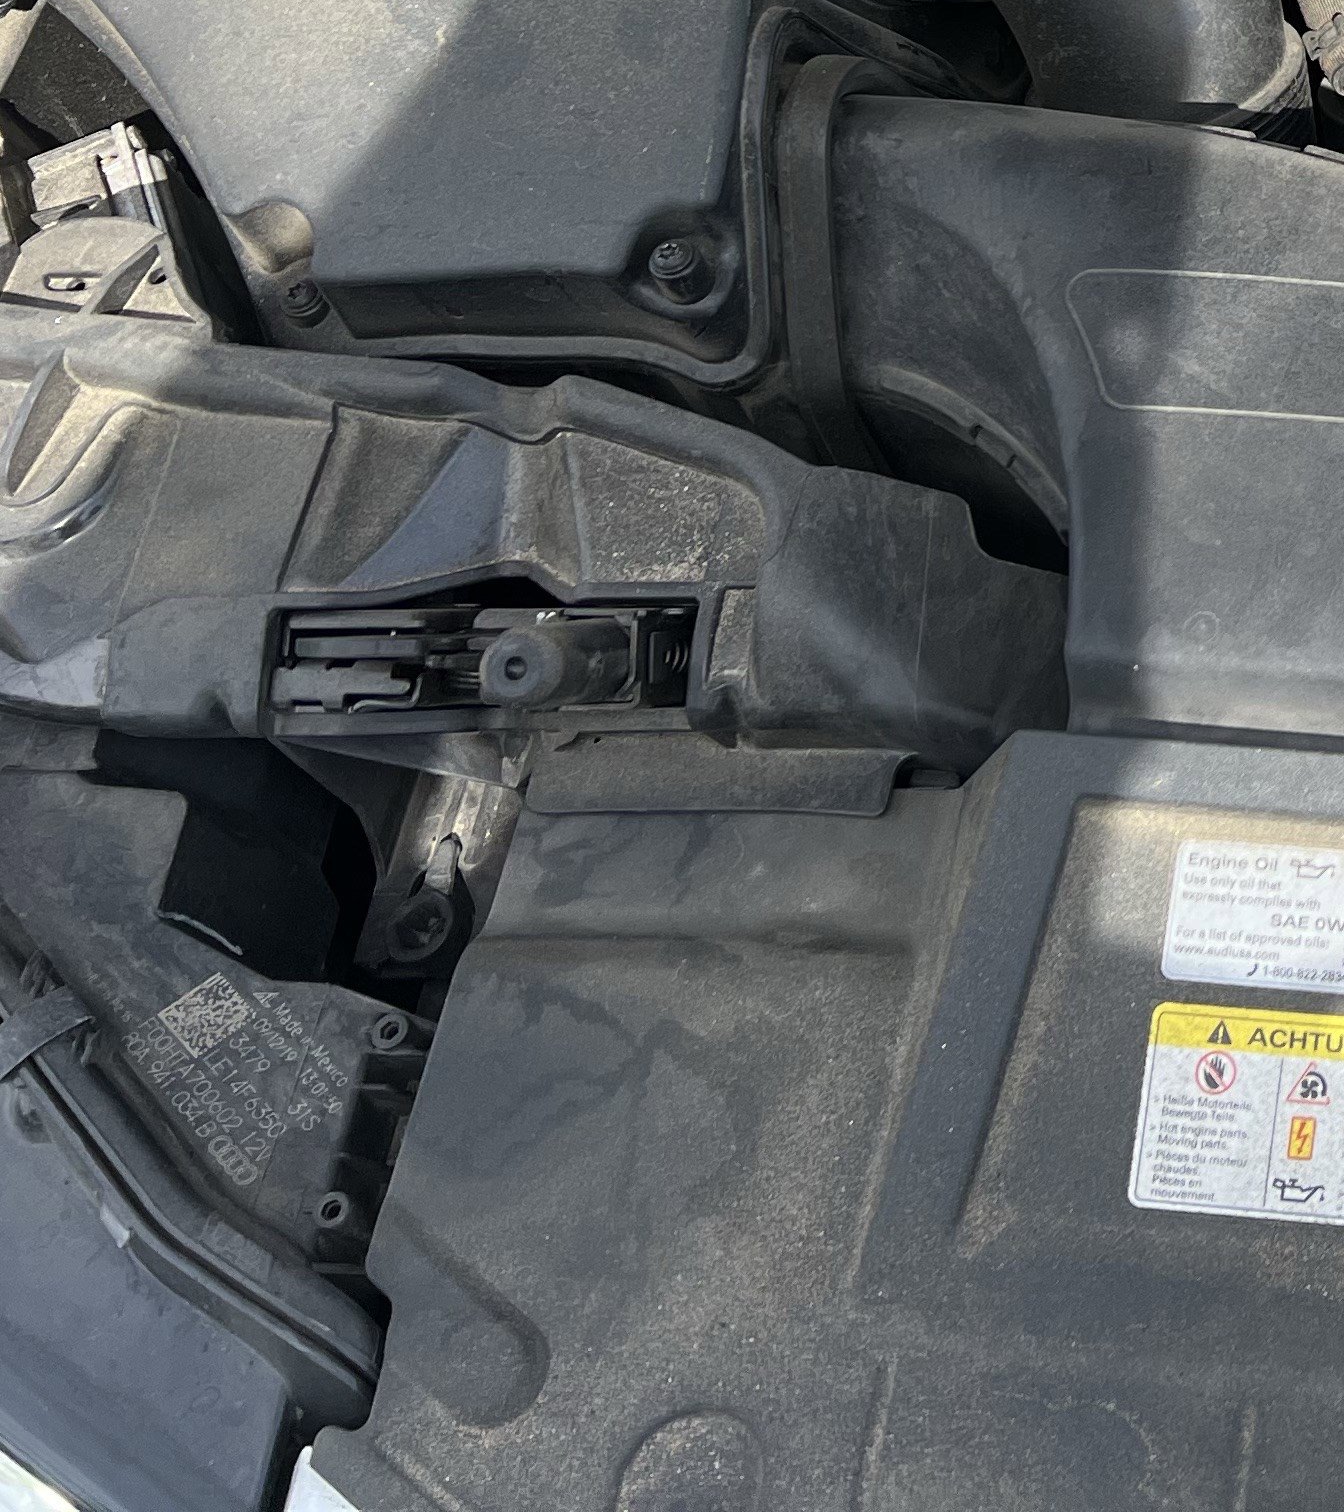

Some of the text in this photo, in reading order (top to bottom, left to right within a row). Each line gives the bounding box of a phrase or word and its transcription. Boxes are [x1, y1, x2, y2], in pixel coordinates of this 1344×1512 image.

[1187, 852, 1278, 874] Engine Oil
[1183, 873, 1207, 886] Use
[1210, 875, 1235, 890] only
[1257, 878, 1281, 892] that
[1239, 893, 1292, 910] complies
[1293, 897, 1321, 910] with
[1270, 913, 1308, 930] SAE
[1175, 926, 1195, 939] For
[1198, 930, 1205, 940] a
[1208, 928, 1227, 942] list
[1229, 930, 1242, 943] of
[1244, 931, 1299, 950] approved
[226, 1032, 272, 1073] 3479
[270, 1002, 301, 1039] Made
[310, 1043, 350, 1089] Mexico
[1159, 1121, 1178, 1132] Hot
[1180, 1125, 1217, 1137] engine
[241, 1130, 272, 1161] 12V
[1157, 1134, 1197, 1148] Moving
[1192, 1152, 1206, 1162] du
[1209, 1155, 1247, 1167] moteur
